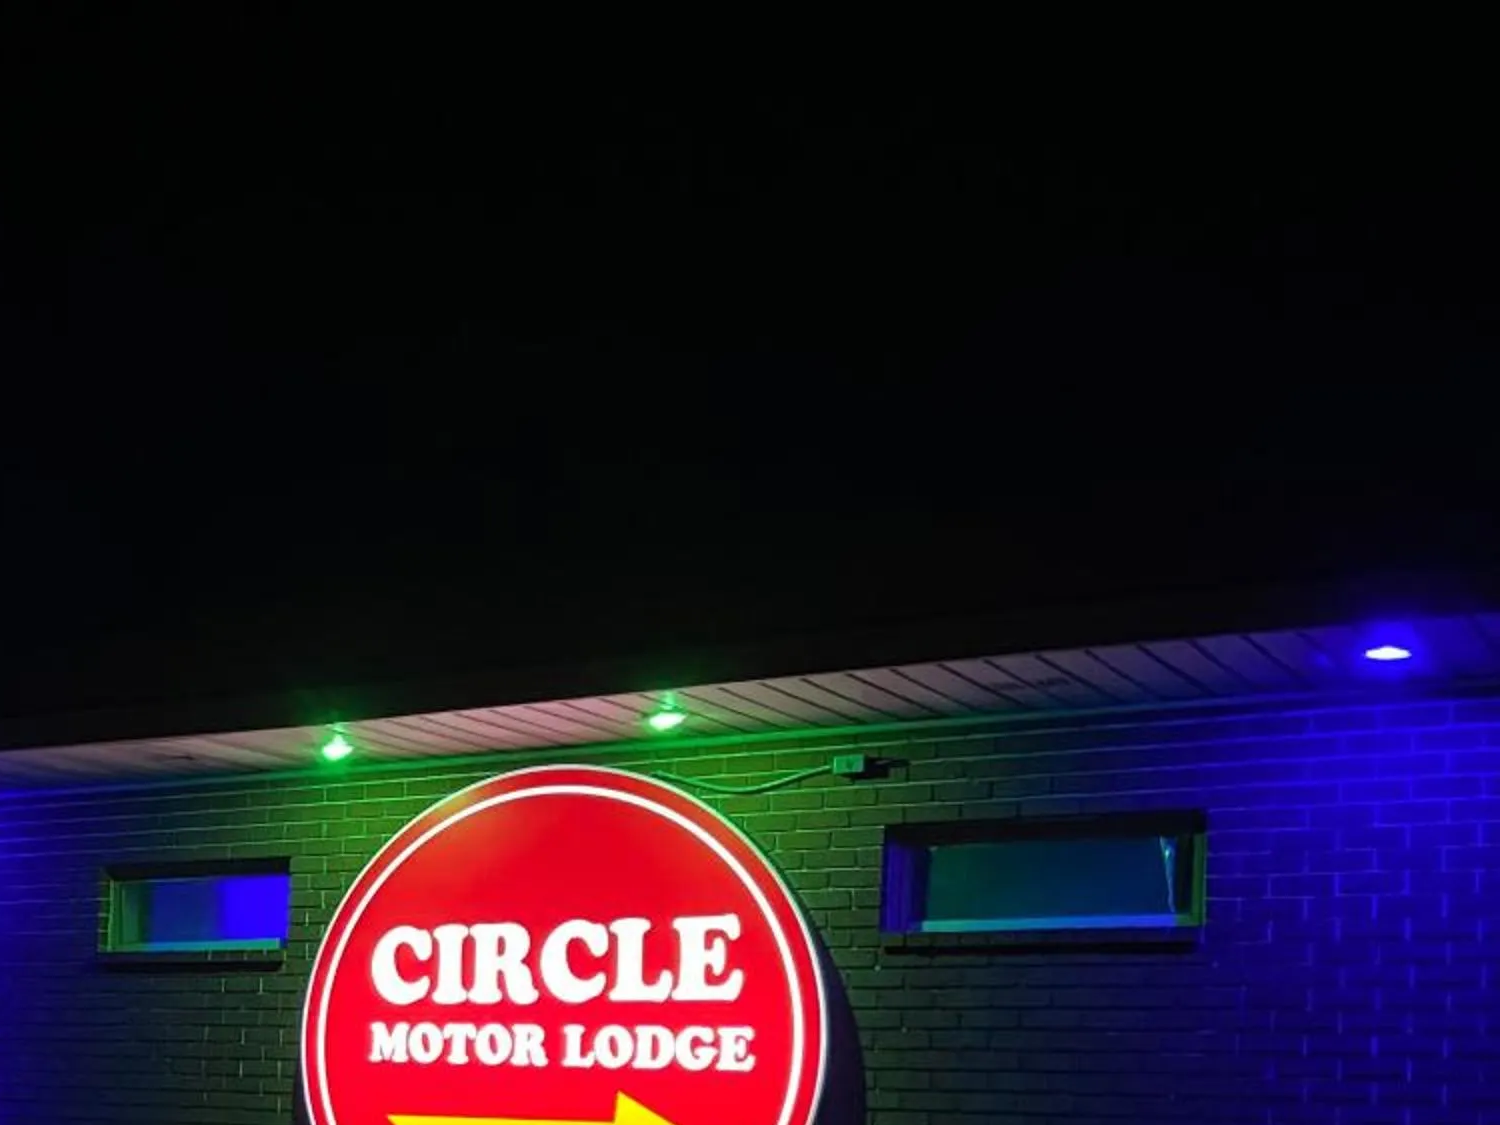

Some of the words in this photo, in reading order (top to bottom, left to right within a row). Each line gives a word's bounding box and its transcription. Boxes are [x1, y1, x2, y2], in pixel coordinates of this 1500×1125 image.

[370, 913, 745, 1006] CIRCLE
[368, 1022, 548, 1068] MOTOR
[560, 1025, 756, 1073] LODGE
